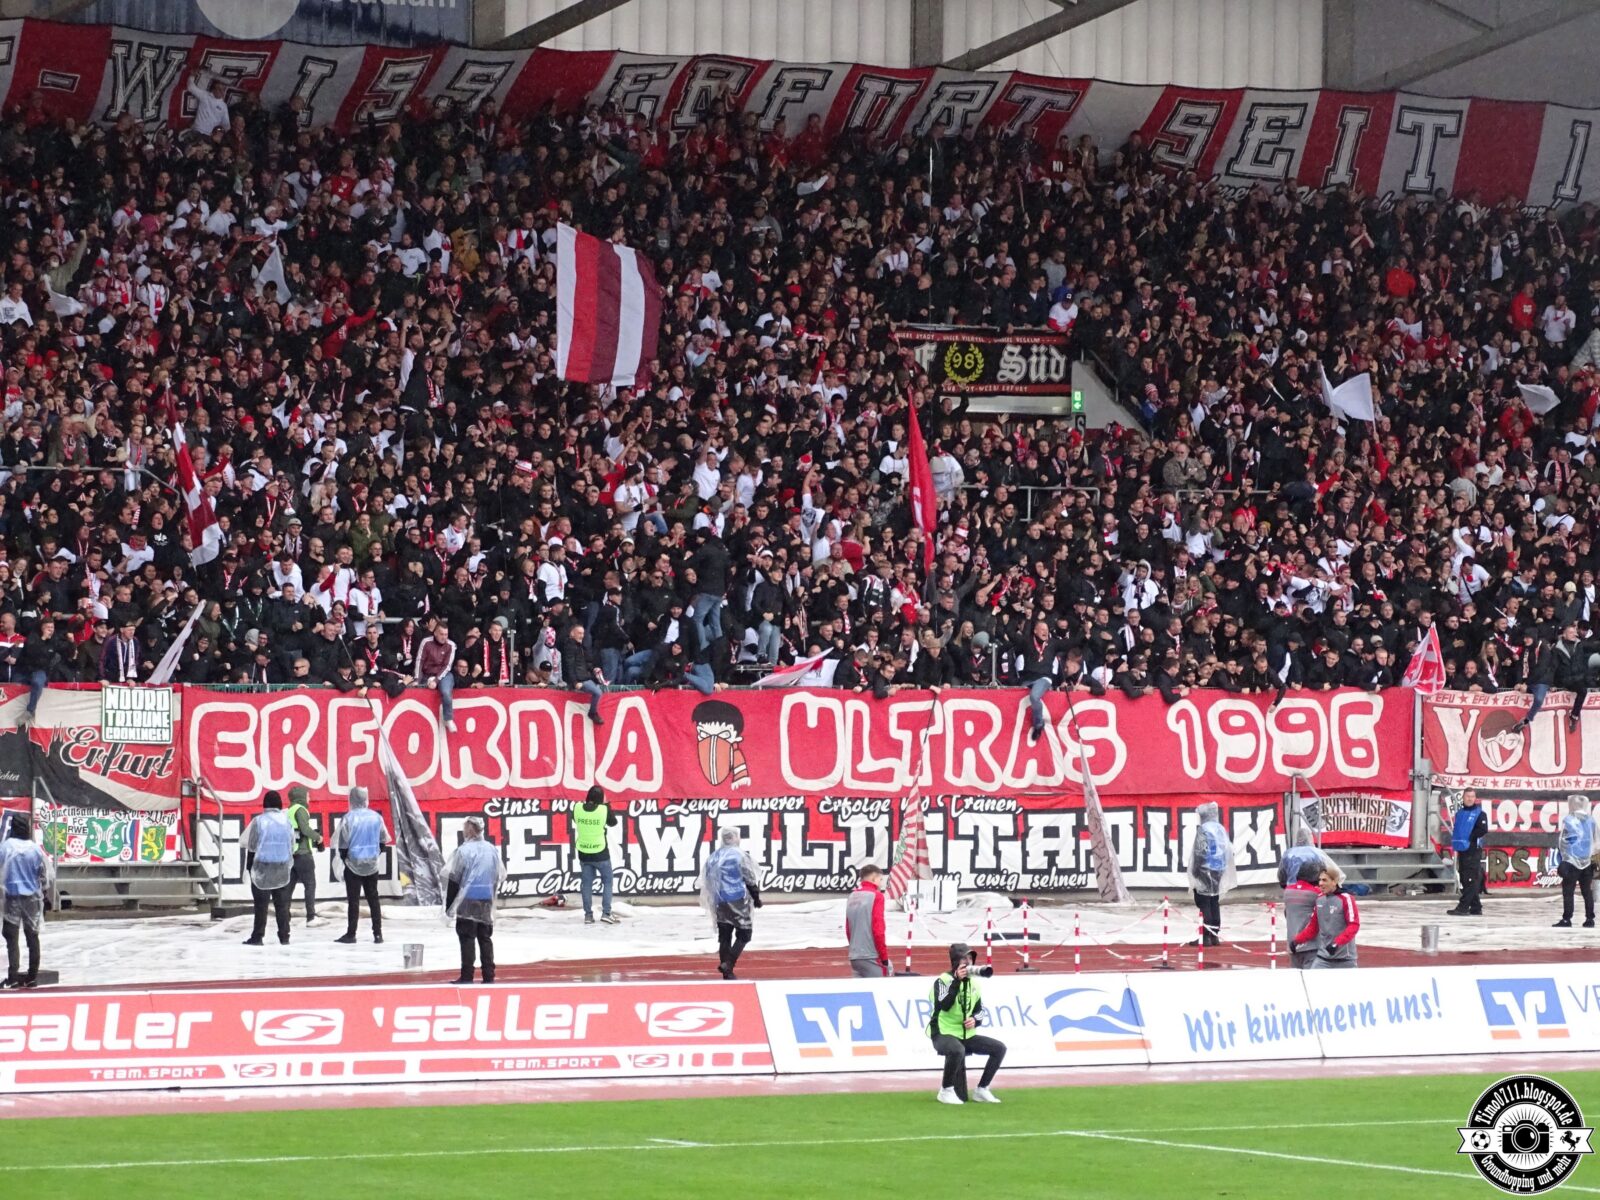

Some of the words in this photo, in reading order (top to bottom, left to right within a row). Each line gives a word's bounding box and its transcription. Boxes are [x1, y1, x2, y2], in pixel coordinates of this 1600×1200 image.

[602, 57, 1073, 142] ERFURT
[1148, 97, 1465, 195] SEIT
[952, 352, 975, 370] 98
[997, 343, 1067, 384] Süd
[105, 688, 170, 711] NOORD
[1435, 694, 1456, 704] EFU
[1472, 694, 1490, 705] EFU
[1502, 695, 1520, 705] EFU
[105, 710, 170, 727] TRIBUNE
[60, 726, 176, 779] Erfurt
[190, 694, 664, 801] ERFORDIA
[781, 691, 1127, 792] ULTRAS
[1166, 691, 1384, 785] 1996
[1472, 776, 1489, 787] EFU
[1503, 777, 1522, 788] EFU
[484, 797, 541, 817] Einst
[629, 797, 658, 817] Du
[664, 797, 729, 818] Zeuge
[741, 797, 805, 812] unserer
[819, 795, 890, 820] Erfolge
[937, 794, 1024, 817] Tränen,
[67, 825, 88, 835] RWE
[72, 817, 85, 827] FC
[577, 818, 601, 826] PRESSE
[538, 869, 603, 895] Glaz
[612, 868, 683, 892] Deiner
[975, 868, 1018, 891] ewig
[1032, 866, 1089, 889] sehnen
[391, 994, 608, 1044] saller
[979, 995, 1039, 1028] ank
[1183, 1010, 1237, 1053] Wir
[1245, 1000, 1377, 1044] kümmern
[1387, 976, 1443, 1025] uns!
[0, 1002, 213, 1053] saller
